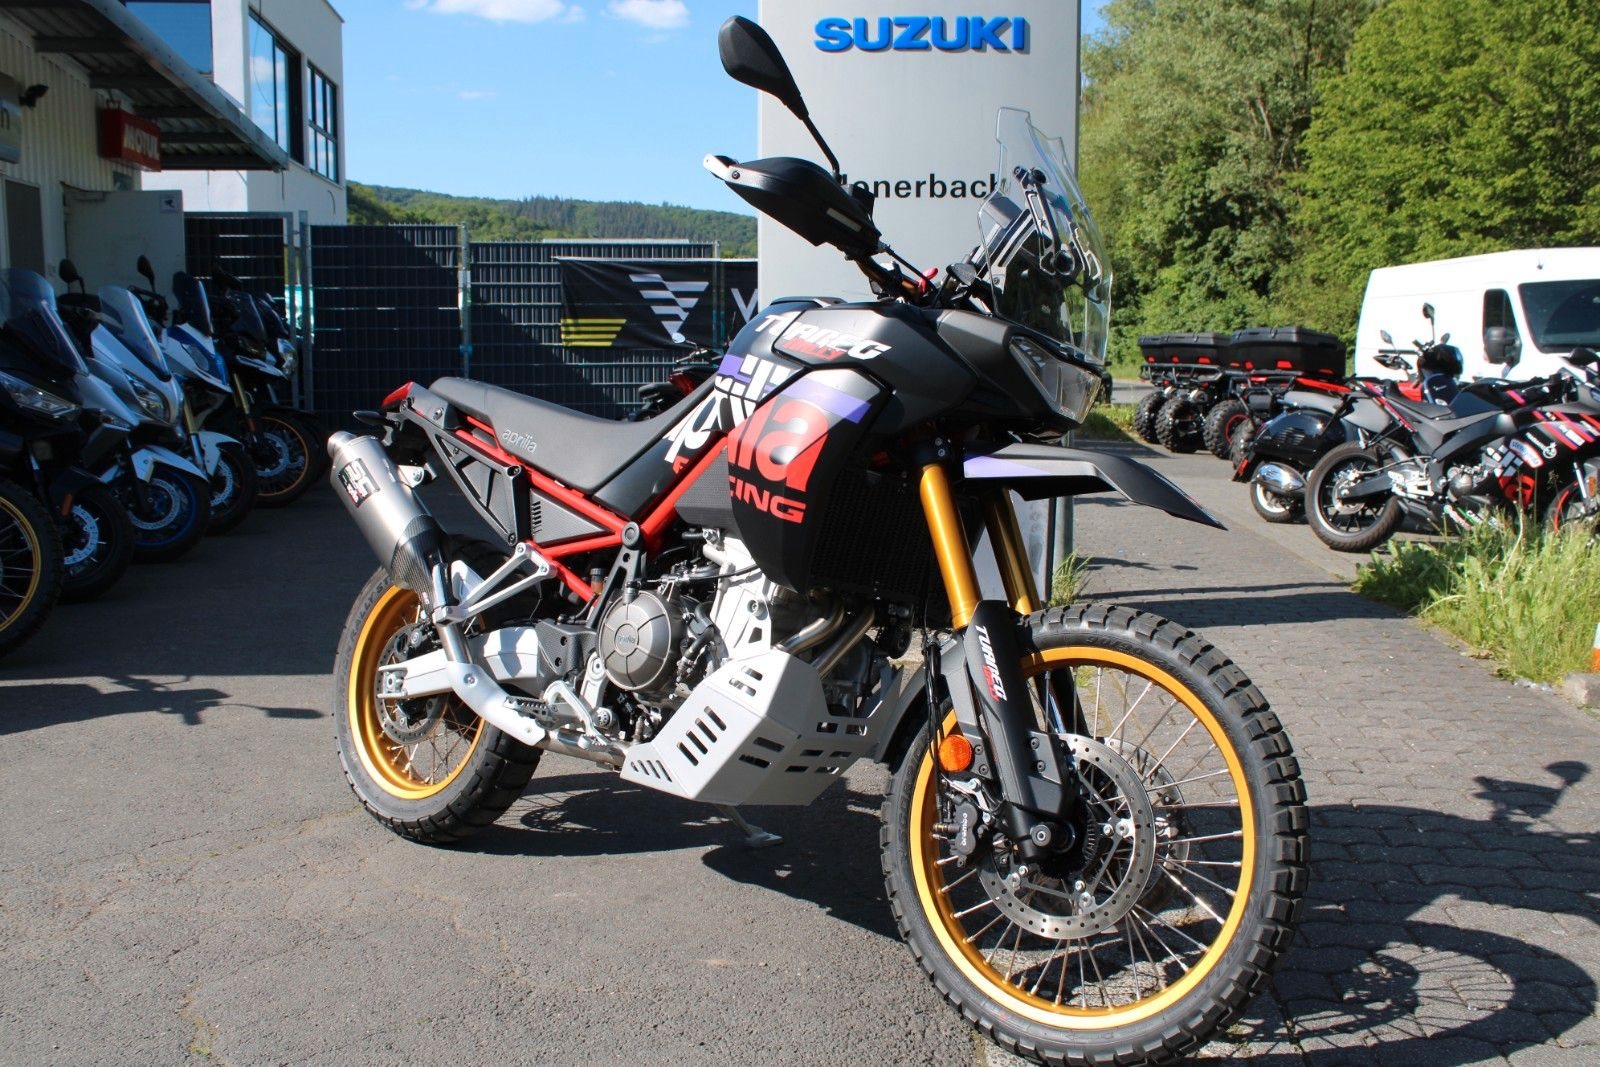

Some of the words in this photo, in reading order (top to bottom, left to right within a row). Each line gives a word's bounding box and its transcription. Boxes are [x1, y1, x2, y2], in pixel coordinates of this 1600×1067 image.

[814, 16, 1026, 52] SUZUKI
[123, 123, 160, 161] MOTUL
[502, 429, 537, 453] aprilia
